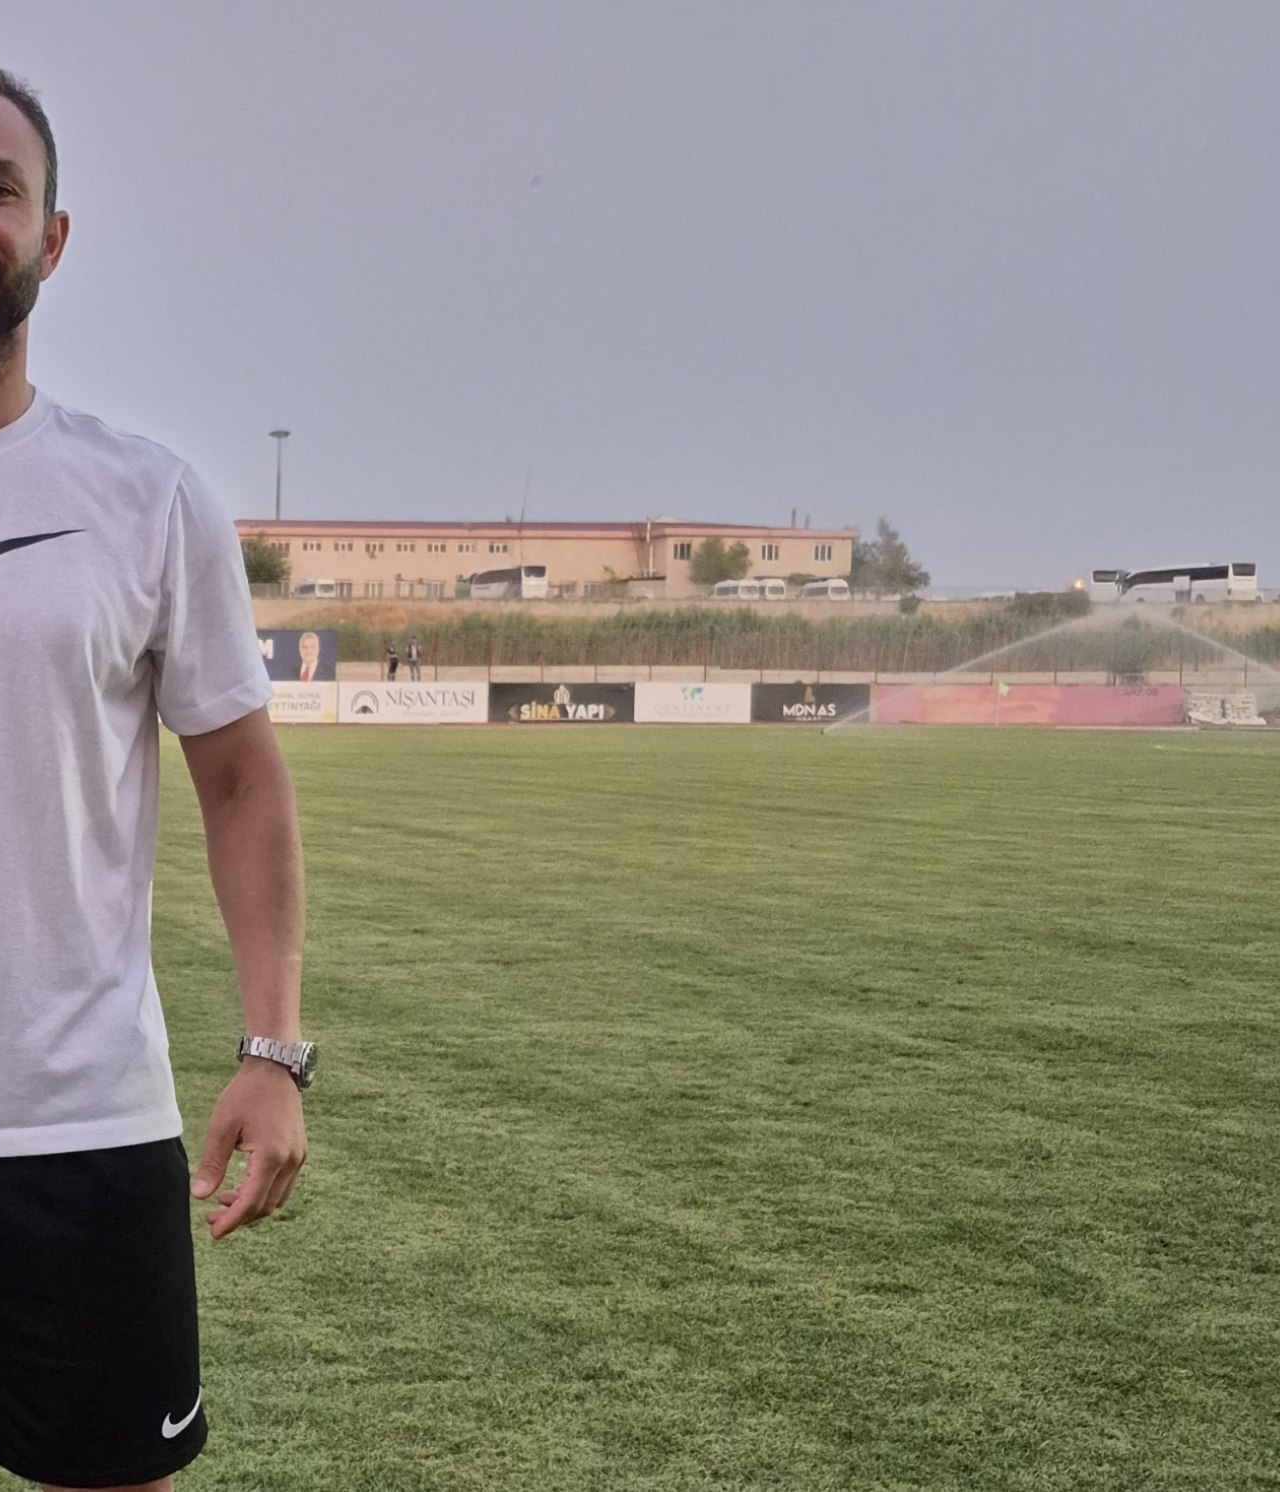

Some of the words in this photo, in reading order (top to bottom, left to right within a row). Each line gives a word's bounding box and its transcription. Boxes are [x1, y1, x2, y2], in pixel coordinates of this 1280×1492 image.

[385, 687, 476, 709] NİŞANTAŞI
[520, 701, 560, 720] SİNA
[565, 703, 605, 720] YAPI
